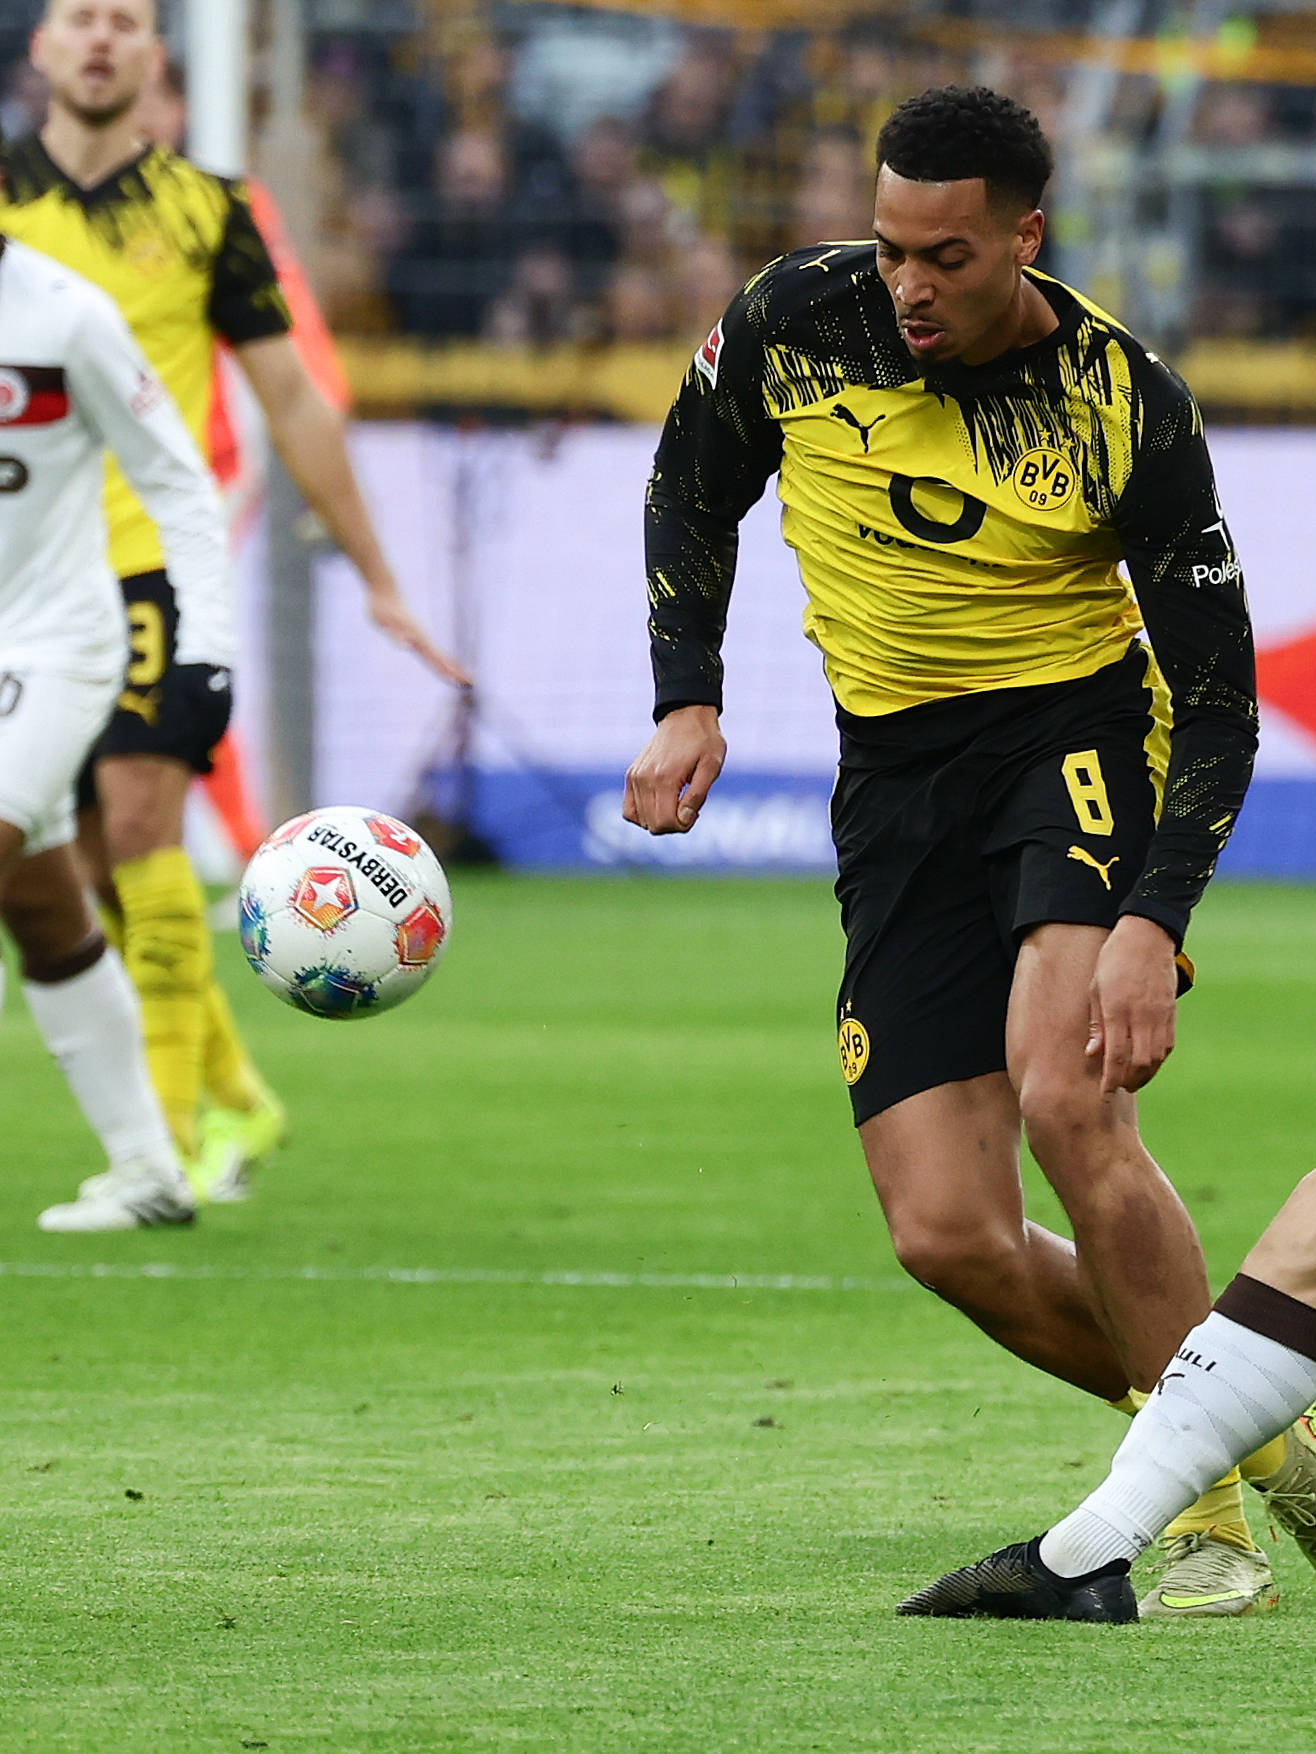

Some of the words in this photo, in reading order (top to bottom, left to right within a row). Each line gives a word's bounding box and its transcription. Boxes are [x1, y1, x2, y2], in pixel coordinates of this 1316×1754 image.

[1019, 454, 1070, 498] BVB
[1028, 490, 1047, 506] 09
[127, 600, 166, 686] 3
[1061, 749, 1115, 837] 8
[307, 826, 409, 909] DERBYSTAR
[840, 1025, 864, 1071] BVB
